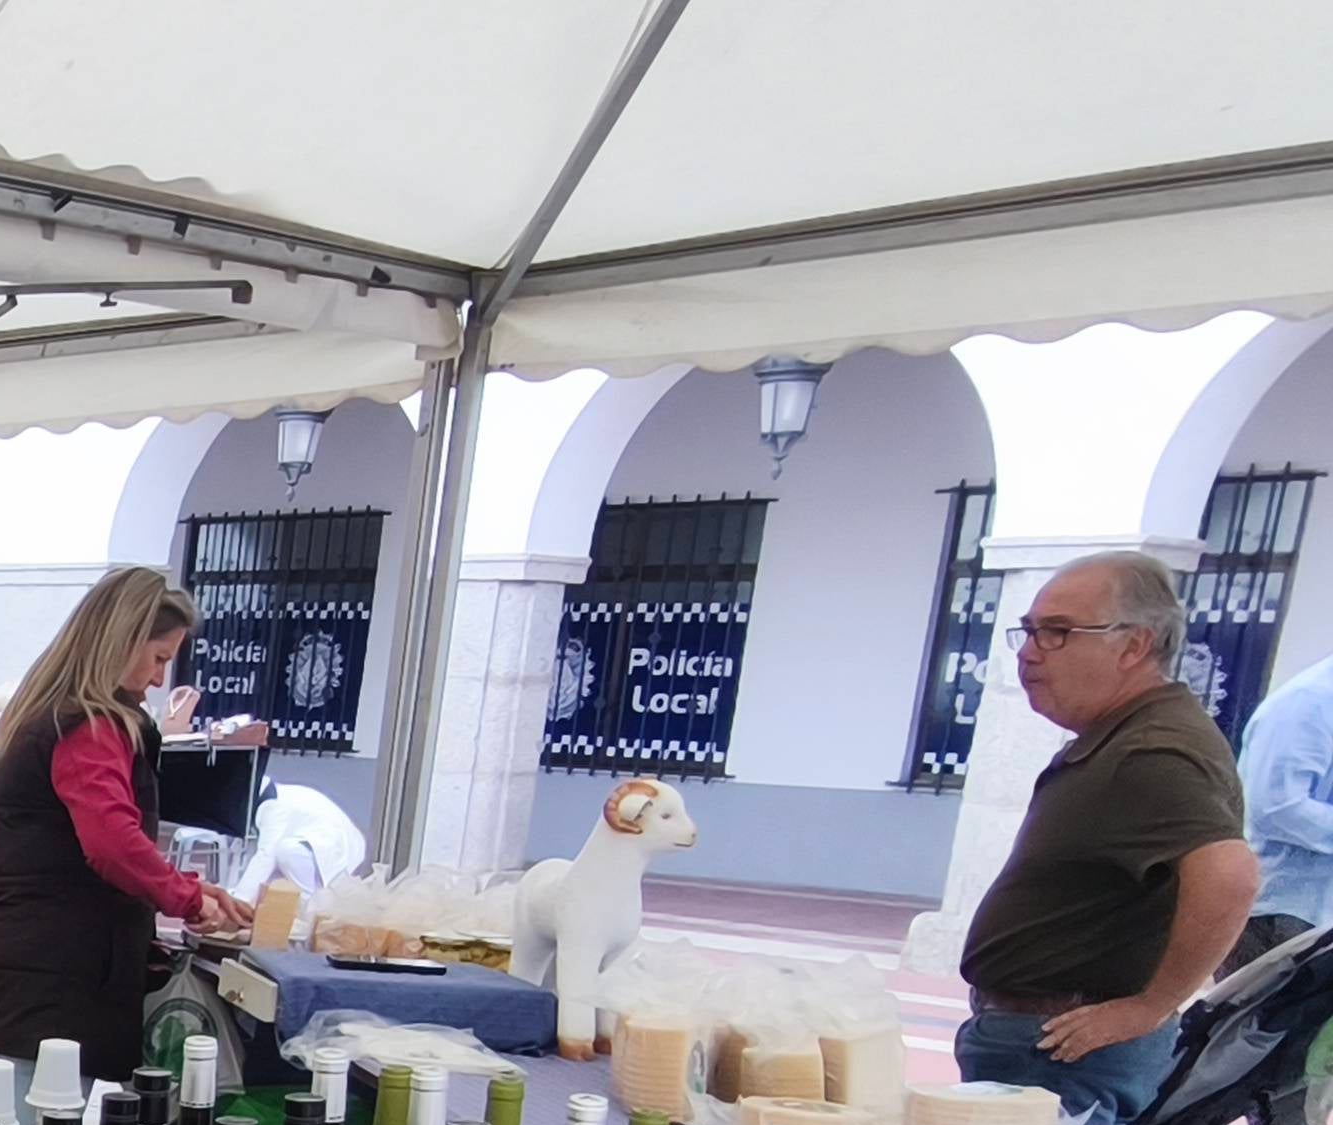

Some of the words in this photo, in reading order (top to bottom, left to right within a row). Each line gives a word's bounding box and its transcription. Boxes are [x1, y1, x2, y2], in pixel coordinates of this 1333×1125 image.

[191, 637, 266, 663] Policía
[628, 646, 733, 677] Policía
[194, 670, 254, 694] Local
[631, 685, 720, 715] Local
